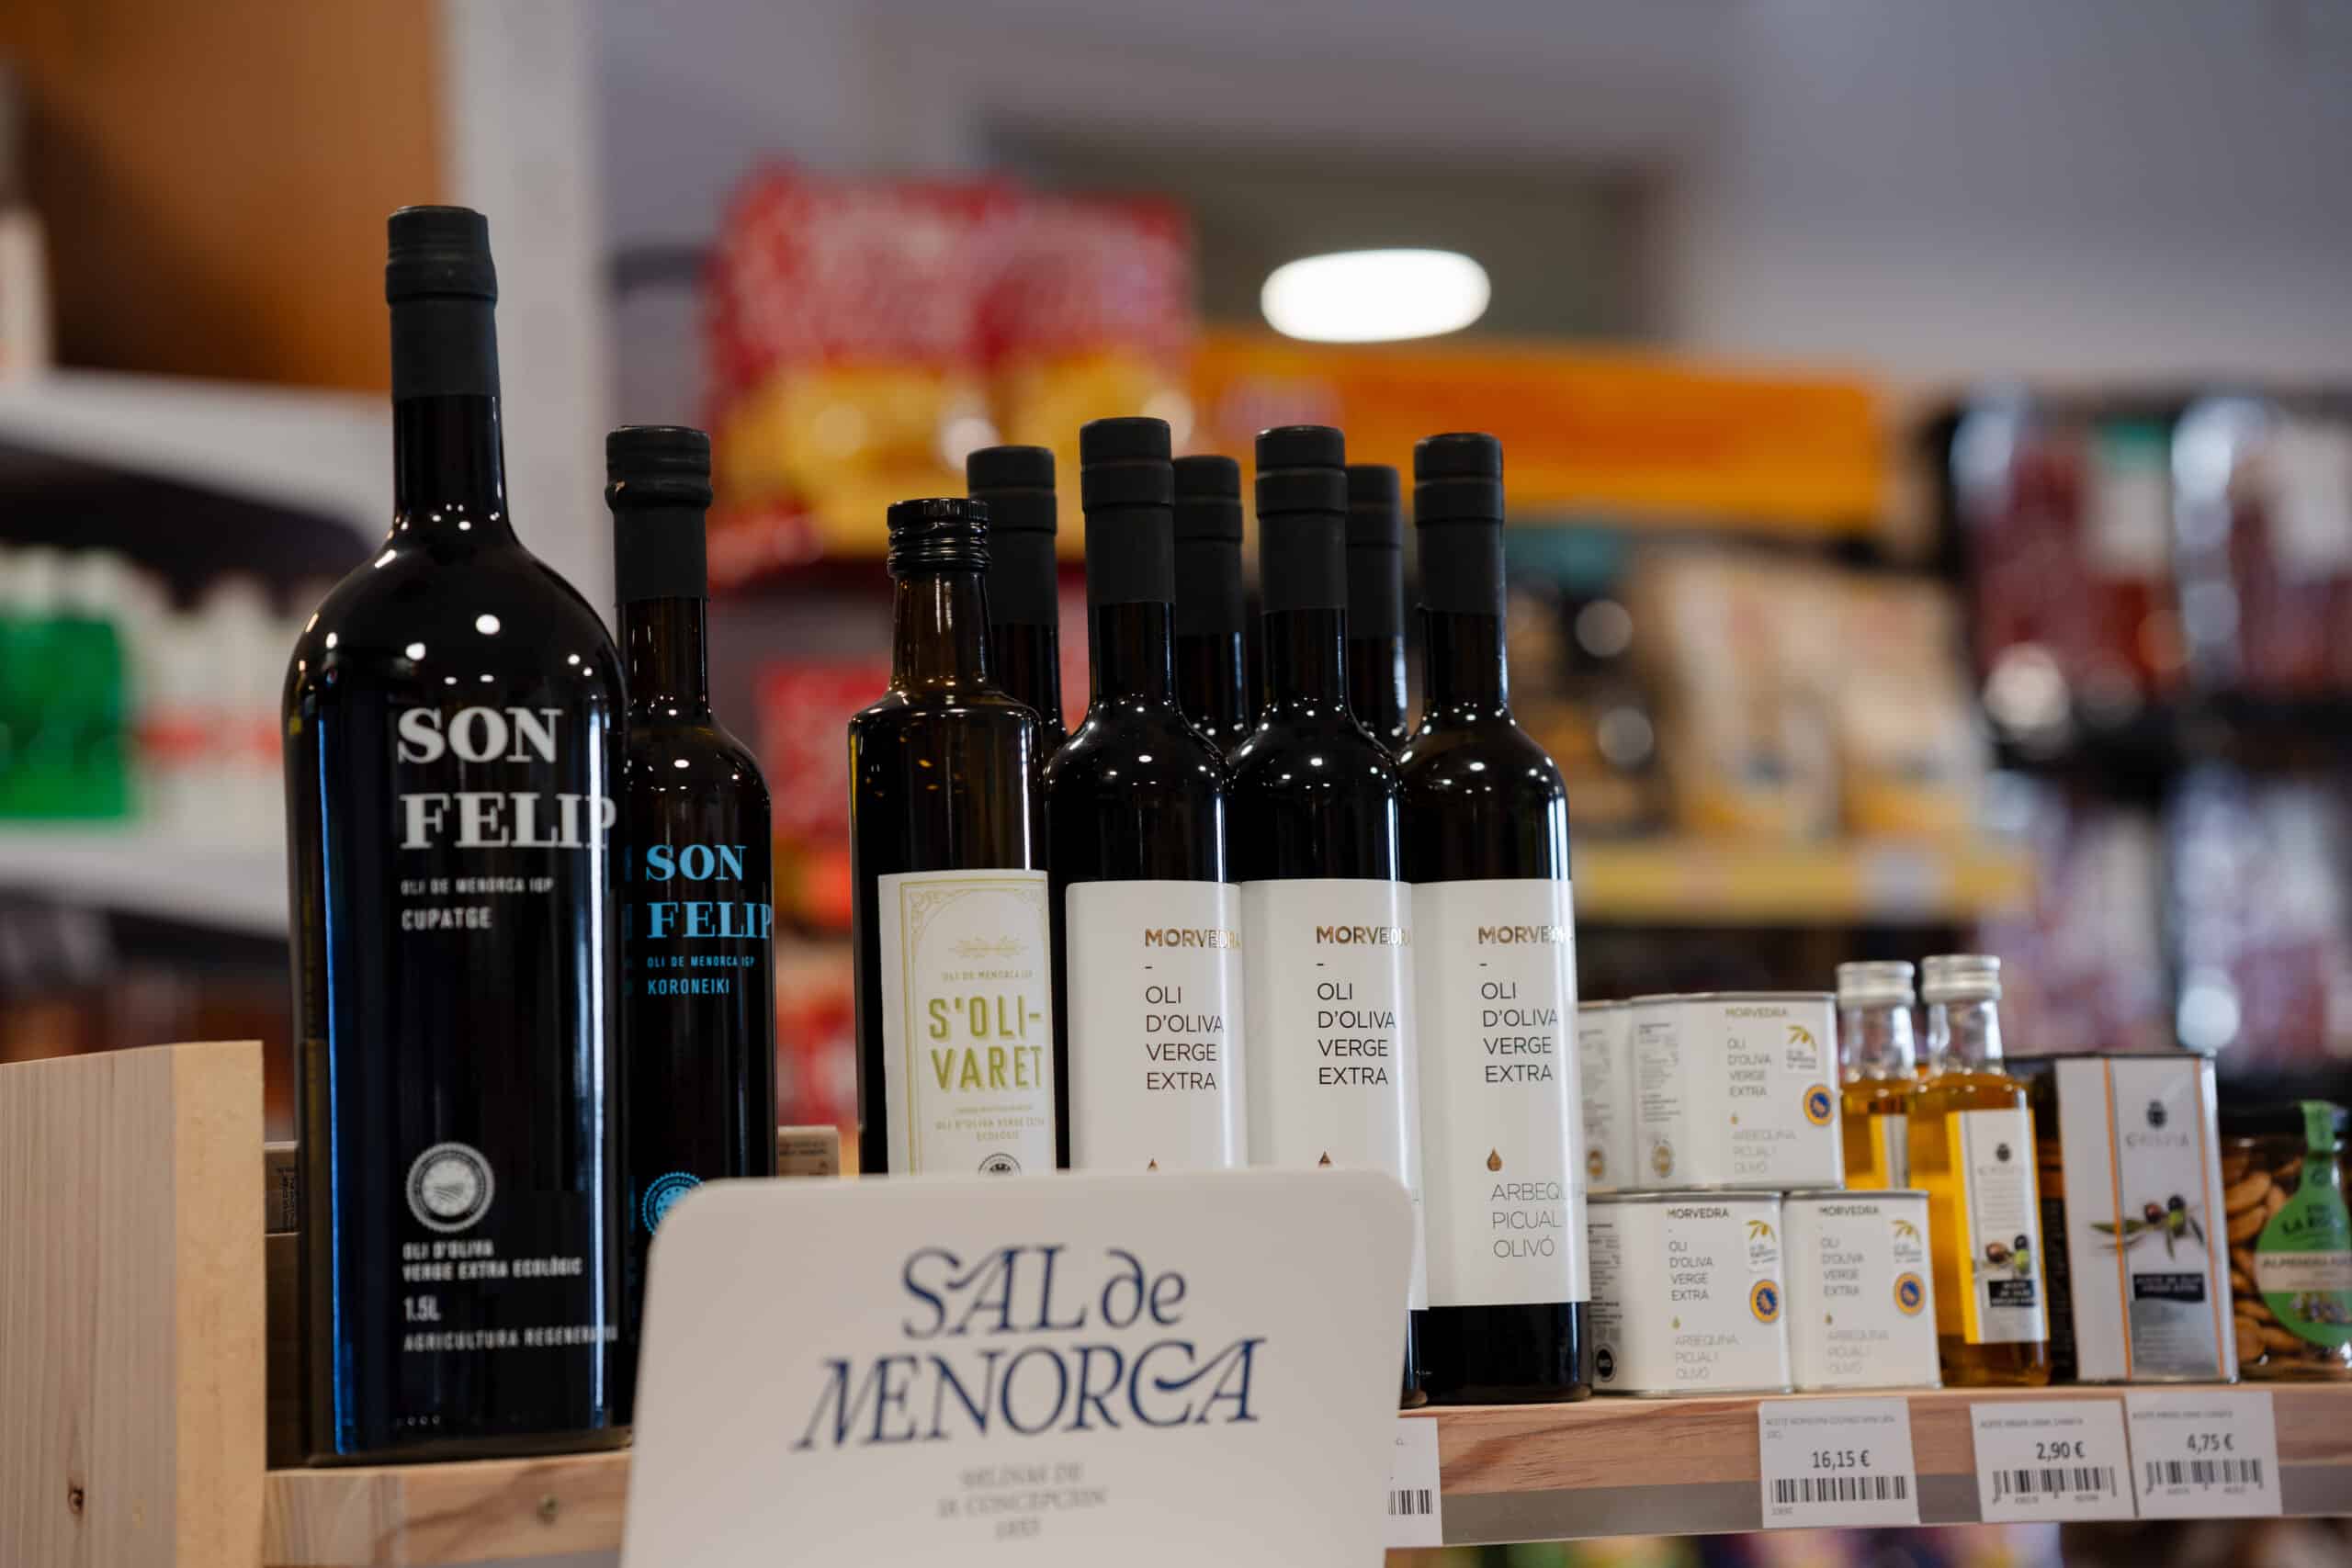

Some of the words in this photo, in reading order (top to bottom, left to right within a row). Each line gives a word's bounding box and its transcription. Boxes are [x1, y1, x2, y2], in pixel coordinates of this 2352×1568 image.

[398, 706, 563, 764] SON
[399, 791, 617, 850] FELIP
[646, 844, 748, 881] SON
[430, 878, 449, 895] DE
[456, 877, 525, 894] MENORCA
[401, 907, 492, 931] CUPATGE
[647, 901, 773, 939] FELIP
[648, 956, 666, 968] OLI
[670, 956, 685, 968] DE
[690, 955, 738, 967] MENORCA
[648, 978, 729, 996] KORONEIKI
[1145, 986, 1182, 1004] OLI
[1317, 982, 1352, 1000] OLI
[1481, 981, 1517, 1000] OLI
[928, 995, 1045, 1041] S'OLI-
[1146, 1014, 1225, 1032] D'OLIVA
[1317, 1010, 1396, 1029] D'OLIVA
[1483, 1009, 1558, 1028] D'OLIVA
[1146, 1043, 1217, 1062] VERGE
[1317, 1038, 1389, 1057] VERGE
[1483, 1036, 1553, 1055] VERGE
[930, 1045, 1044, 1091] VARET
[1318, 1066, 1389, 1085] EXTRA
[1485, 1064, 1553, 1083] EXTRA
[1147, 1071, 1217, 1090] EXTRA
[1492, 1210, 1564, 1230] PICUAL
[1667, 1208, 1730, 1220] MORVEDRA
[1493, 1235, 1555, 1258] OLIVÓ
[401, 1262, 454, 1282] VERGE
[458, 1260, 509, 1280] EXTRA
[1670, 1273, 1709, 1285] VERGE
[901, 1244, 1087, 1341] SAL
[1101, 1247, 1187, 1330] de
[1671, 1290, 1710, 1302] EXTRA
[402, 1330, 519, 1352] AGRICULTURA
[789, 1337, 1268, 1454] MENORCA
[2036, 1441, 2071, 1461] 2,90
[2075, 1440, 2086, 1459] €
[2187, 1433, 2221, 1454] 4,75
[1812, 1450, 1856, 1471] 16,15
[1860, 1450, 1871, 1468] €
